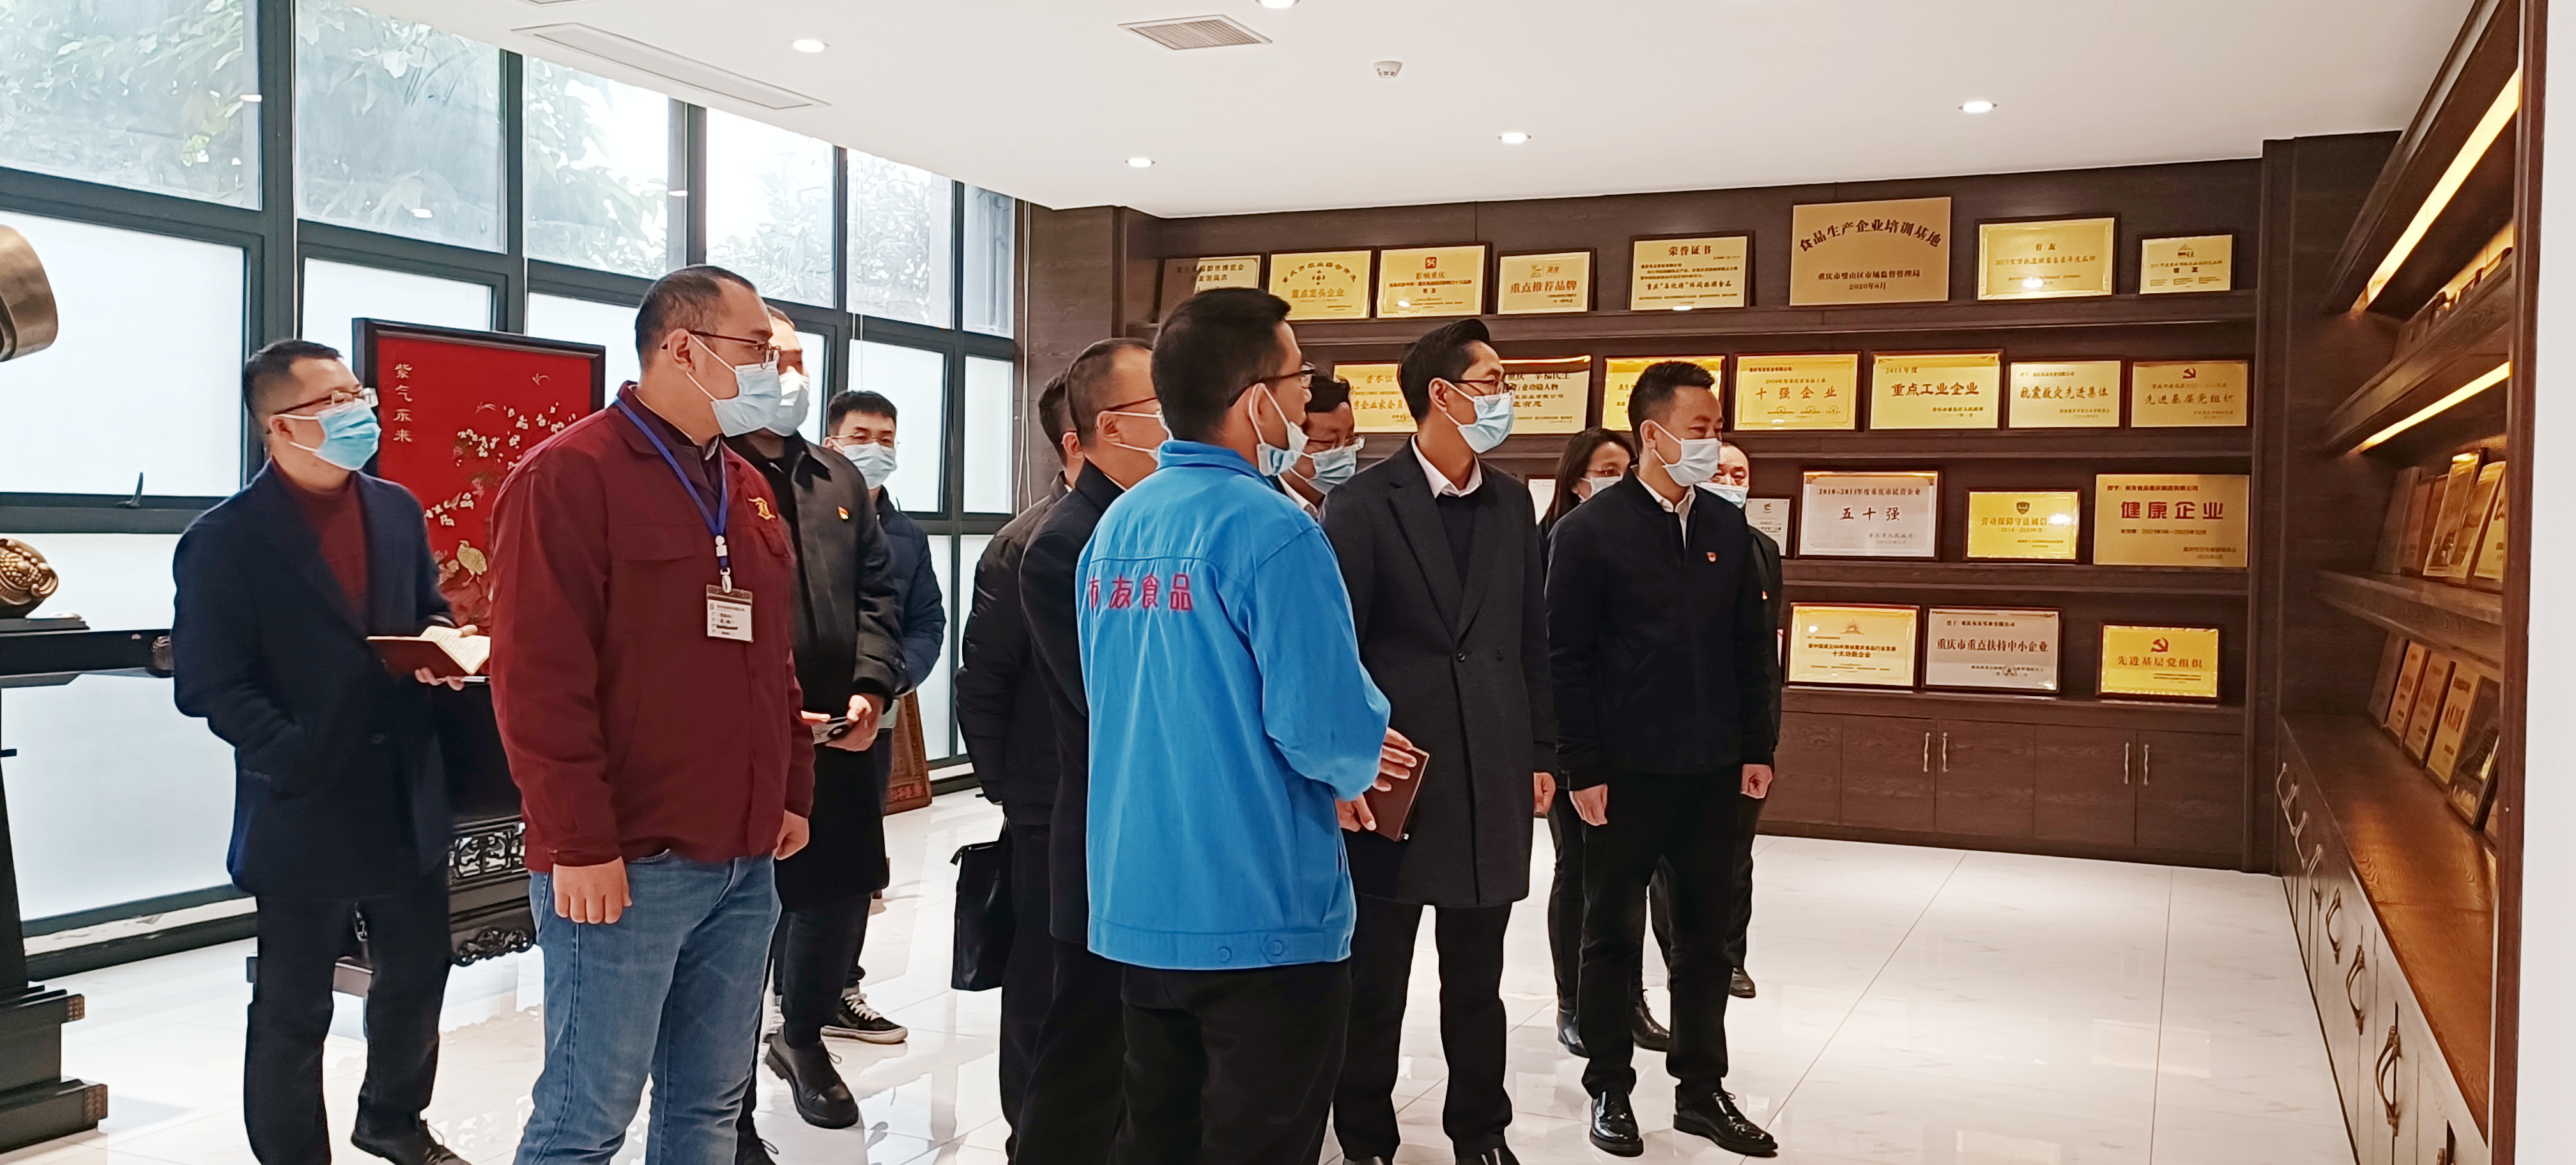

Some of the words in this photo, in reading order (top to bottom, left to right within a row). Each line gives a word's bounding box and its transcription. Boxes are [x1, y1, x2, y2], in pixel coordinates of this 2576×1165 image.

[1799, 219, 1942, 252] 食品生产企业培训基地
[1669, 245, 1712, 256] 荣誉证书
[1416, 271, 1446, 280] 影响重庆
[1818, 270, 1920, 280] 重庆市璧山区市场监督管理局
[1292, 287, 1345, 298] 重点龙头企业
[1510, 280, 1577, 293] 重点推荐品牌
[1849, 282, 1886, 290] 2020年8月
[1755, 385, 1837, 400] 十强企业
[1891, 382, 1979, 397] 重点工业企业
[2020, 386, 2108, 399] 抗震救灾先进集体
[2145, 393, 2234, 405] 先进基层党组织
[1839, 506, 1900, 521] 五十强
[2121, 501, 2223, 519] 健康企业
[1981, 517, 2048, 526] 劳动保障守法诚信
[1937, 638, 2048, 652] 重庆市重点扶持中小企业
[2117, 655, 2202, 668] 先进基层党组织
